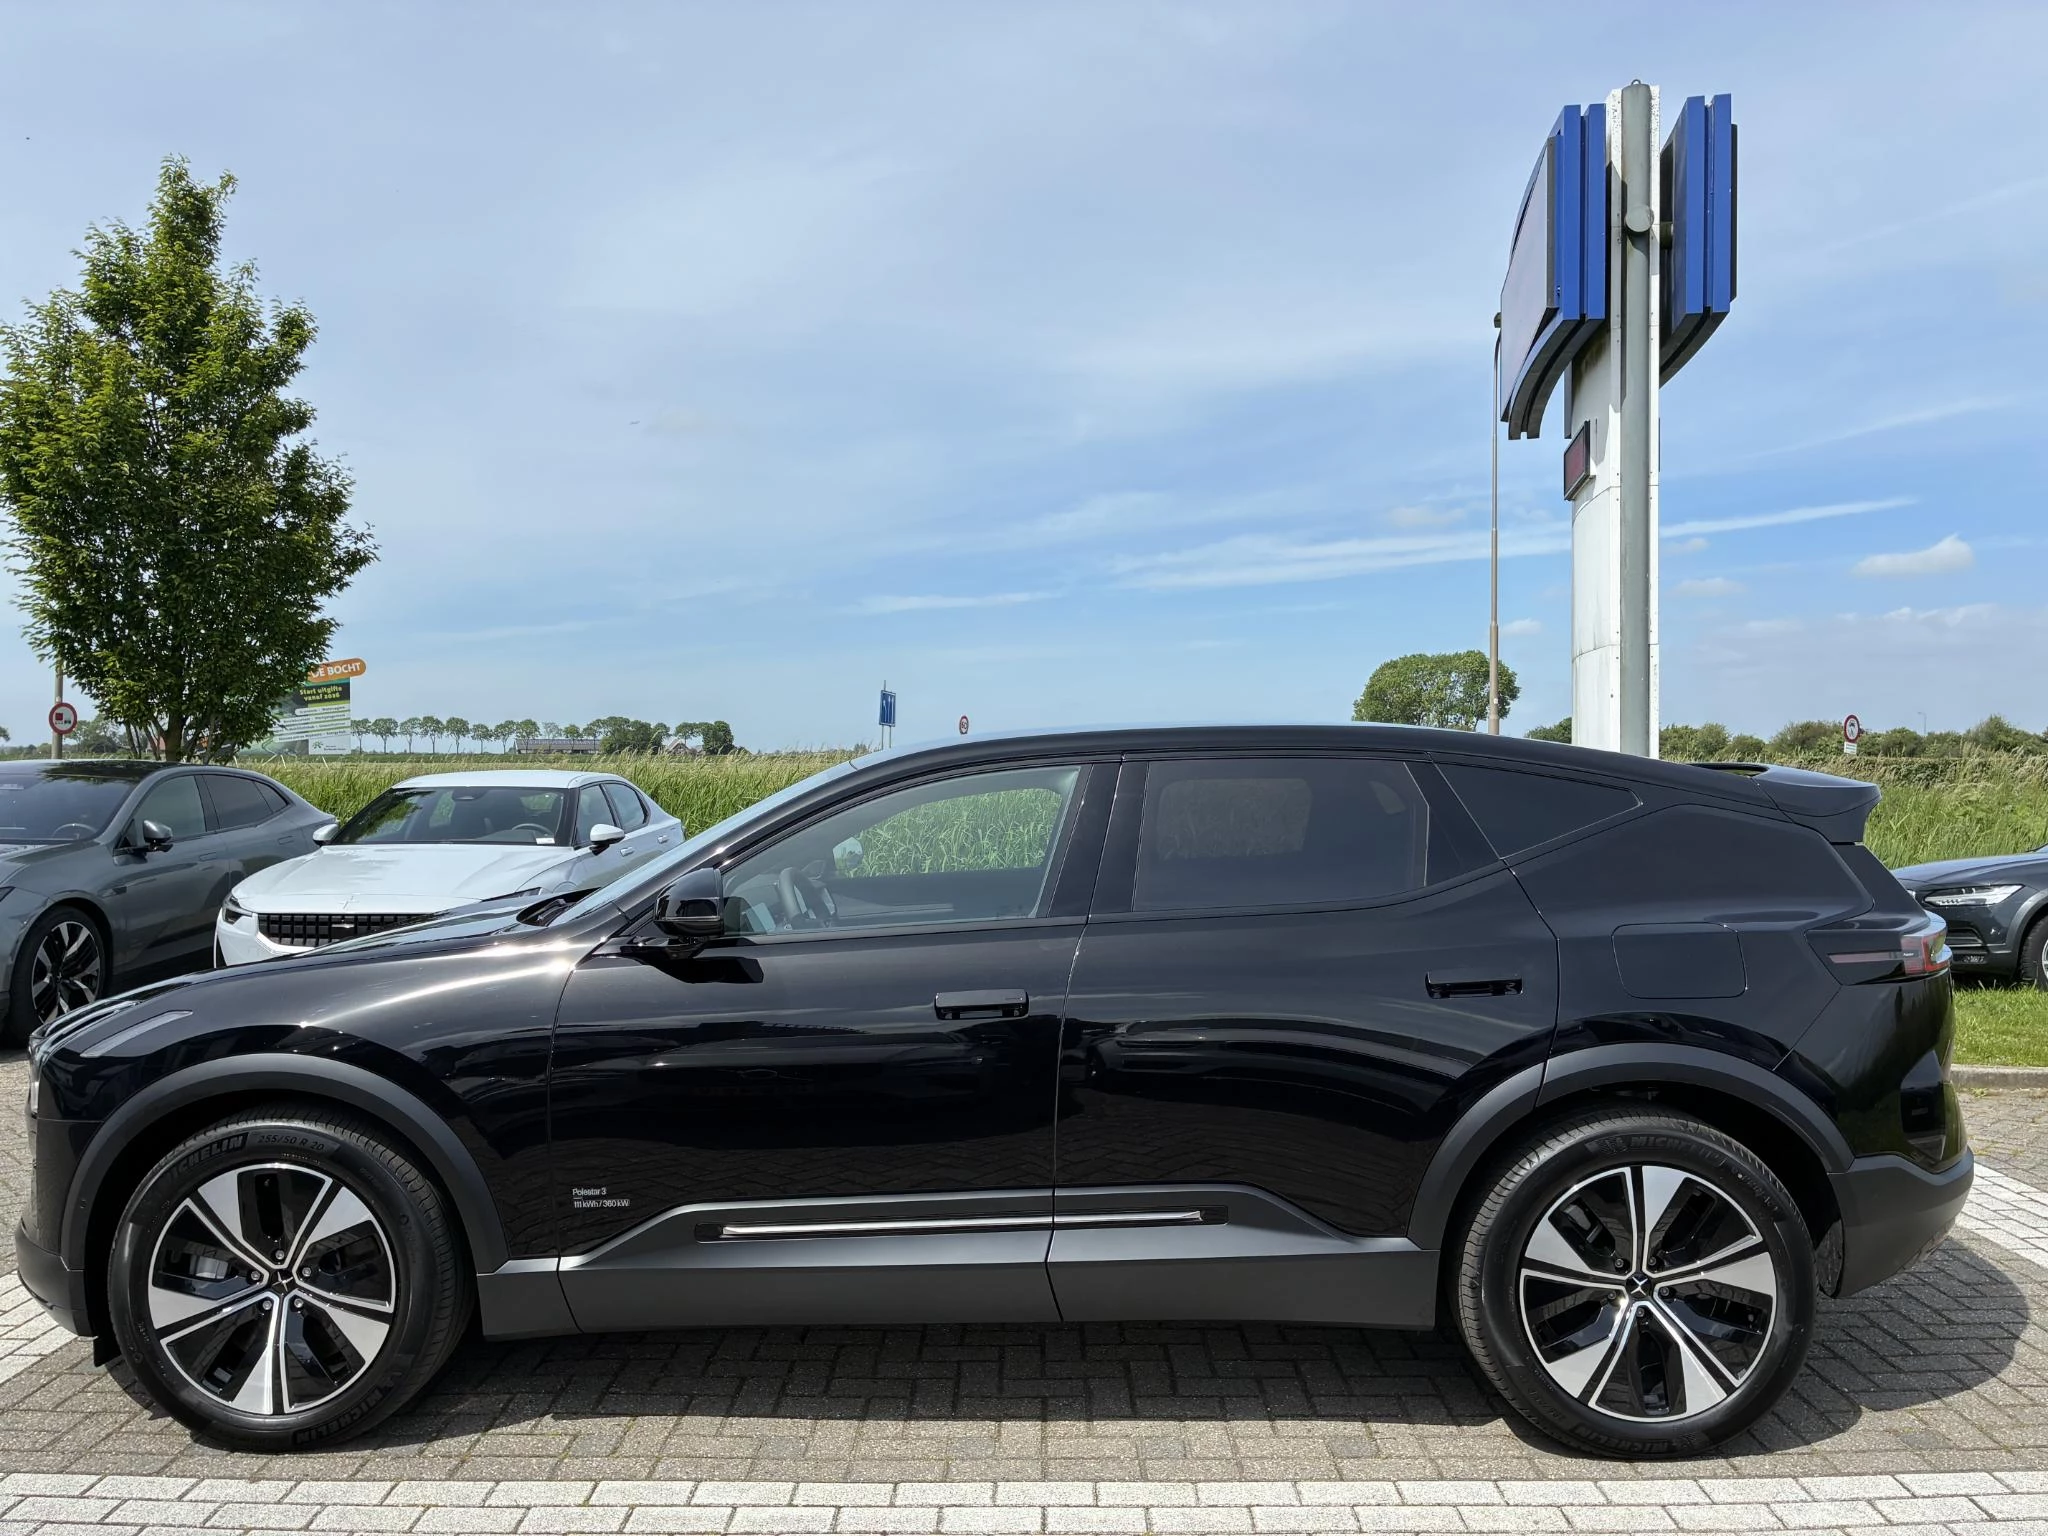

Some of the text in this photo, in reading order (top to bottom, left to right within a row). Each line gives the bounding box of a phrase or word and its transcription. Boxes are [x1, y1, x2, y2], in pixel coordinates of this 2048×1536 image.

[327, 662, 361, 676] BOCHT
[299, 685, 343, 696] Start uitgifte
[303, 693, 323, 701] vanaf
[572, 1187, 607, 1196] Polestar 3
